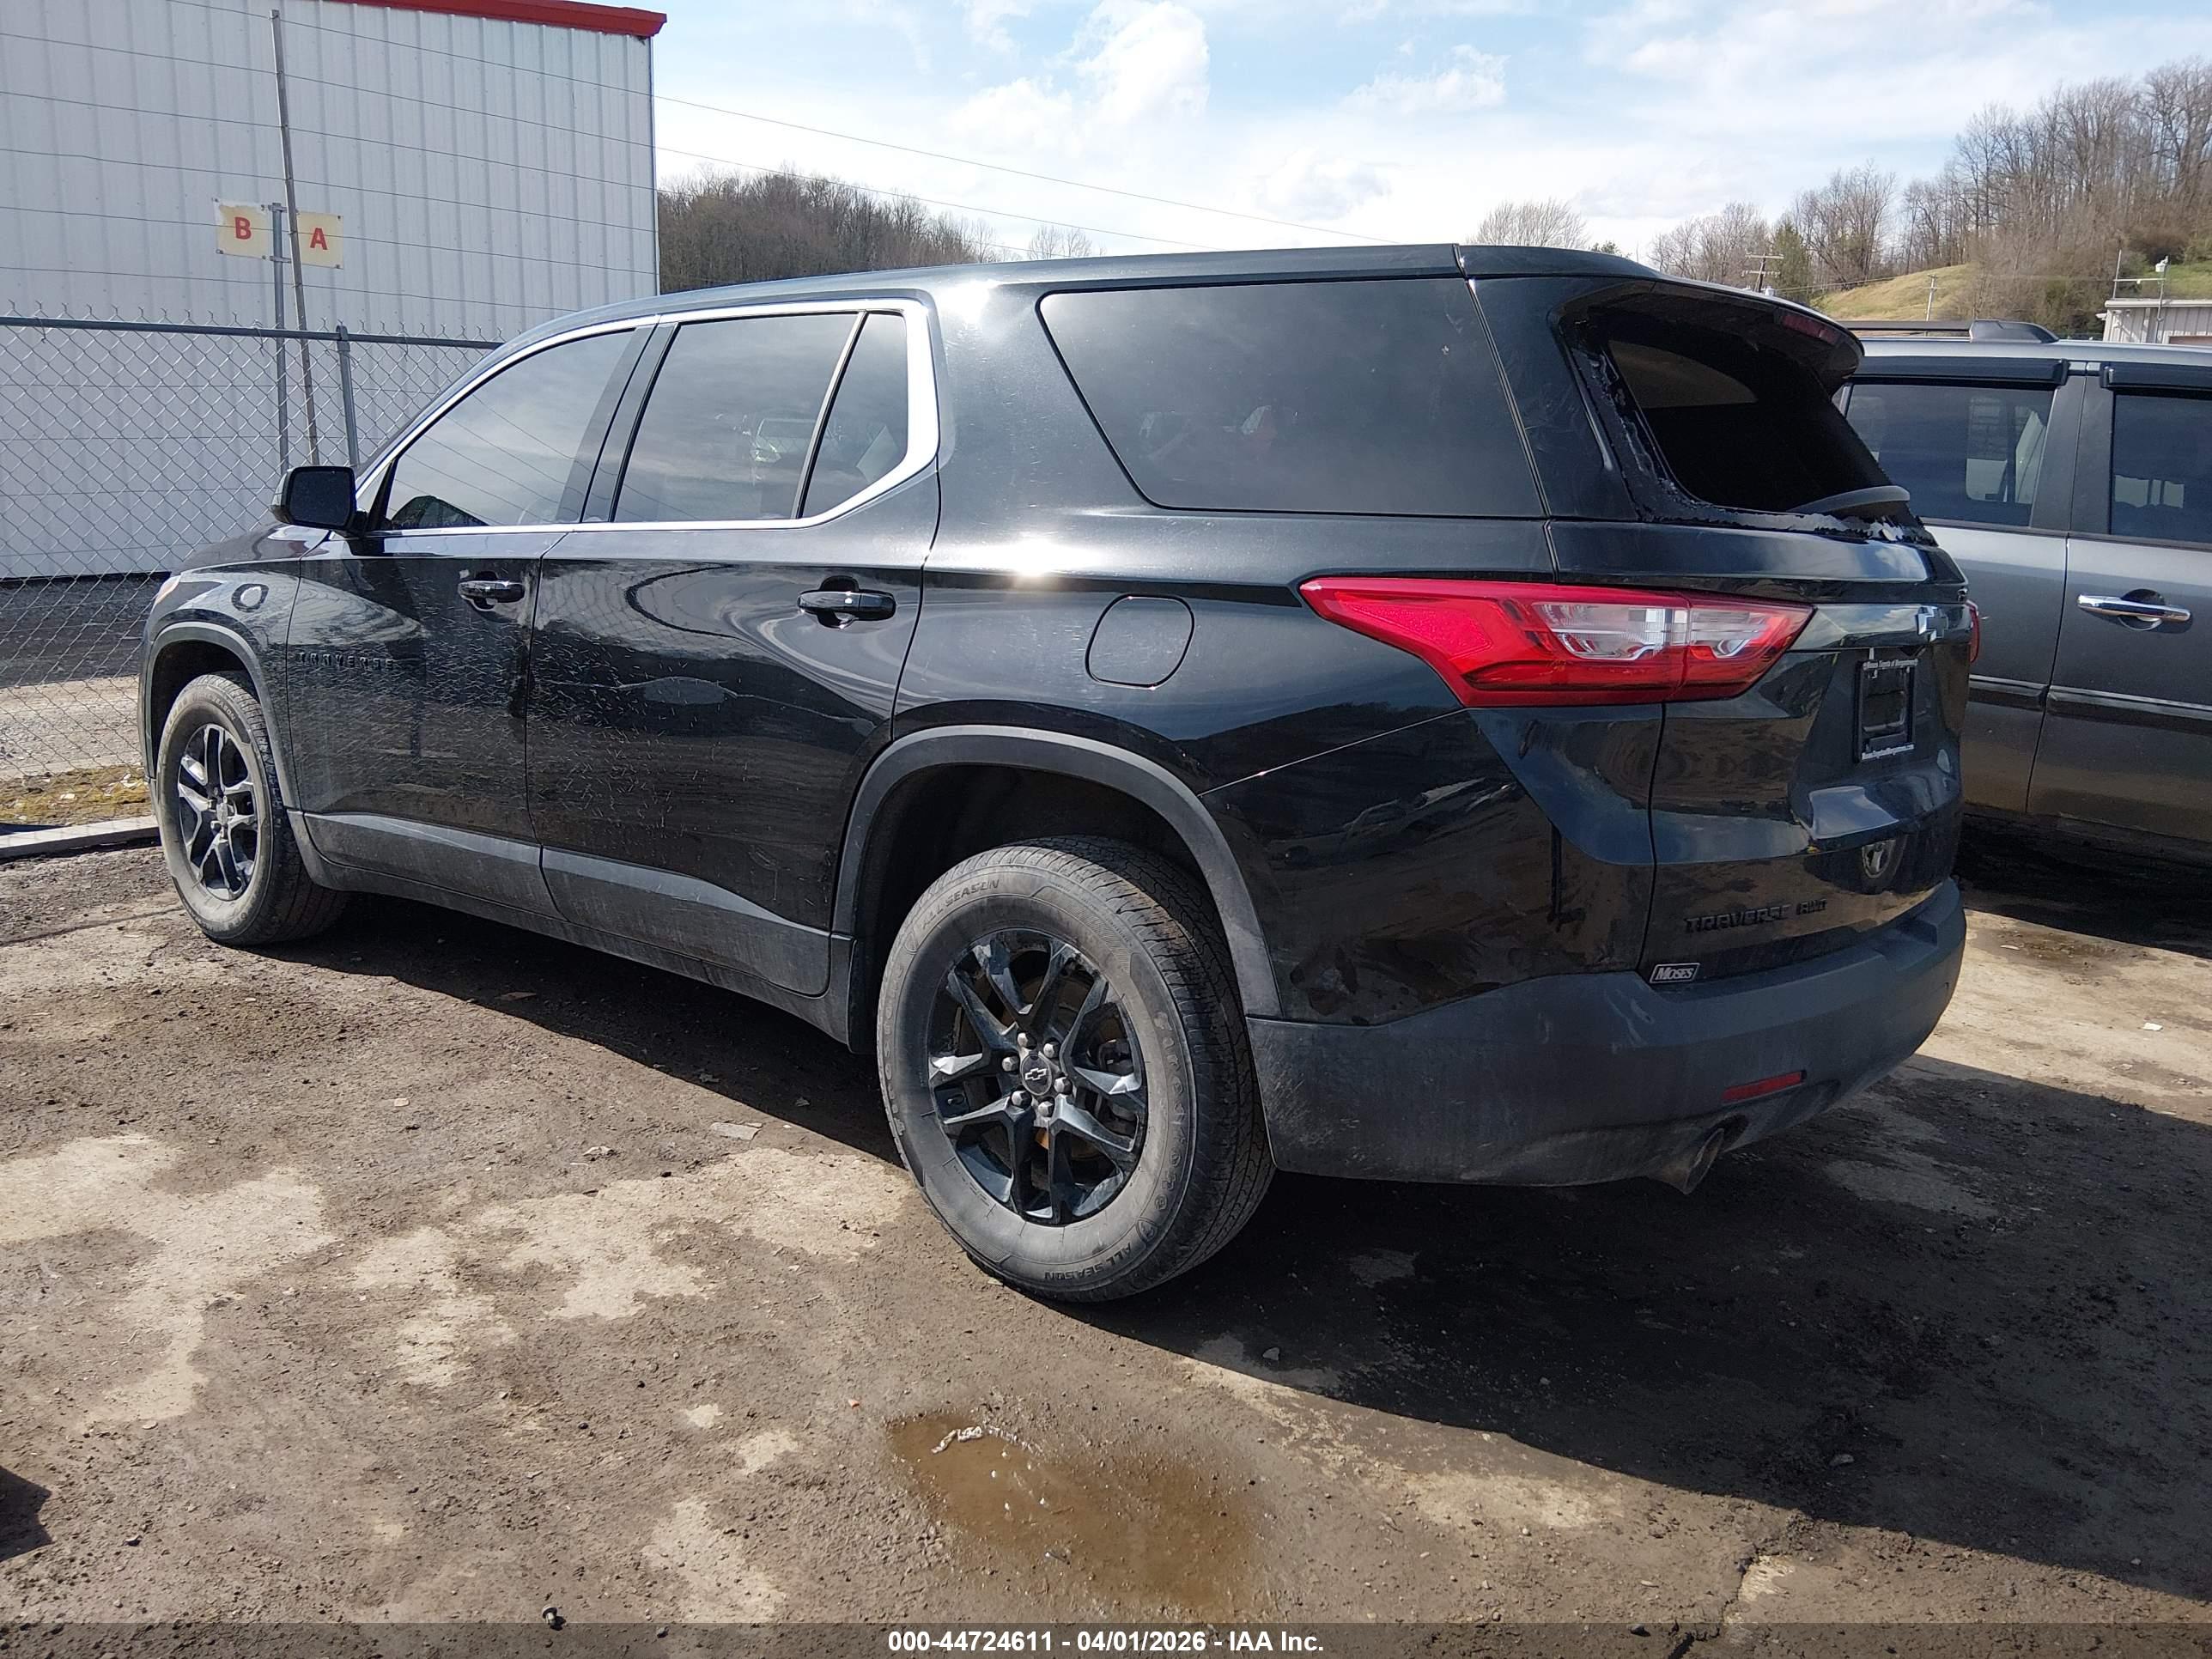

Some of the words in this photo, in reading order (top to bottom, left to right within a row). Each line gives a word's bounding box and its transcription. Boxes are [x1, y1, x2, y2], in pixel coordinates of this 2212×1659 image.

[234, 216, 252, 240] B
[310, 228, 328, 251] A
[945, 878, 1000, 908] SEASON
[1684, 903, 1791, 933] TRAVERSE
